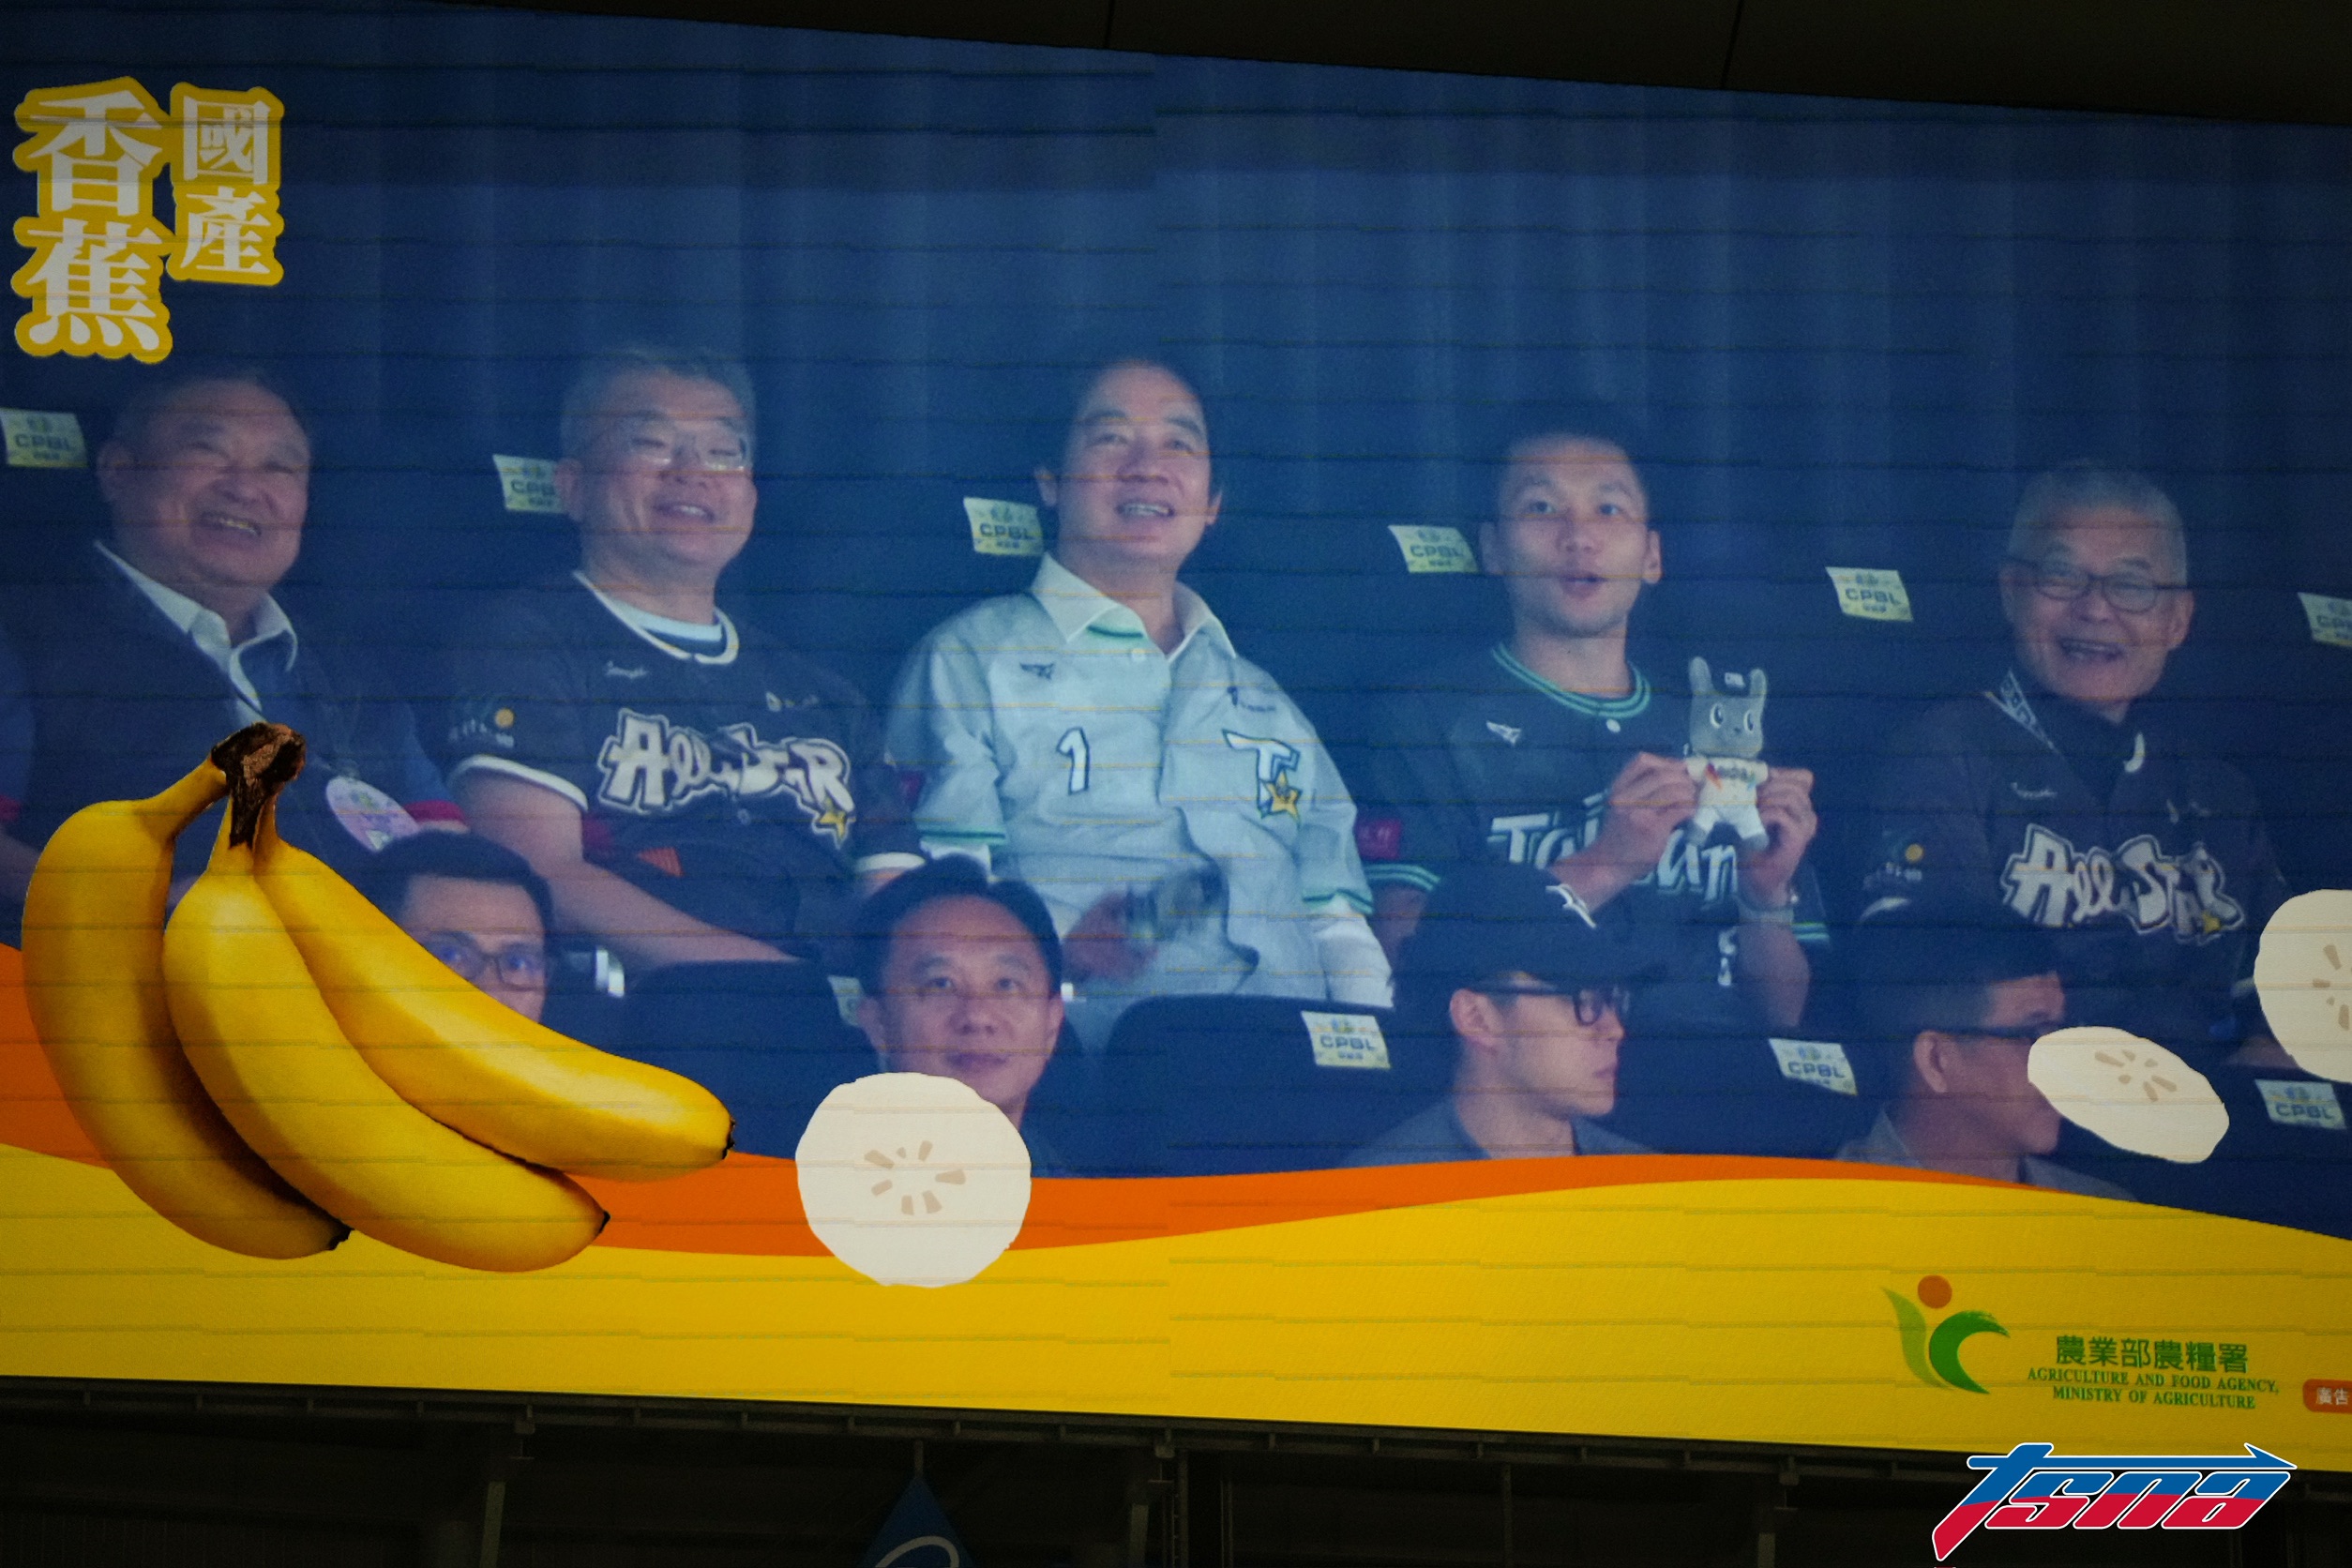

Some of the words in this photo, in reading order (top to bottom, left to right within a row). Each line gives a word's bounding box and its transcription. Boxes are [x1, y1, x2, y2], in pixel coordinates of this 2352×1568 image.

[181, 94, 272, 276] 國產
[26, 89, 162, 352] 香蕉
[510, 479, 555, 496] CPB
[980, 523, 1035, 541] CPBL
[1410, 545, 1464, 559] CPBL
[1845, 588, 1902, 606] CPBL
[1056, 727, 1090, 795] 1
[1320, 1036, 1376, 1051] CPBL
[1787, 1062, 1846, 1078] CPBL
[2275, 1102, 2334, 1120] CPBL
[2057, 1334, 2248, 1374] 農業部農糧署
[2028, 1367, 2129, 1385] AGRICULTURE
[2135, 1373, 2164, 1386] AND
[2172, 1375, 2210, 1389] FOOD
[2218, 1377, 2279, 1395] AGENCY,
[2053, 1385, 2122, 1402] MINISTRY
[2128, 1389, 2148, 1404] OF
[2153, 1391, 2255, 1410] AGRICULTURE
[2315, 1387, 2348, 1406] 廣告
